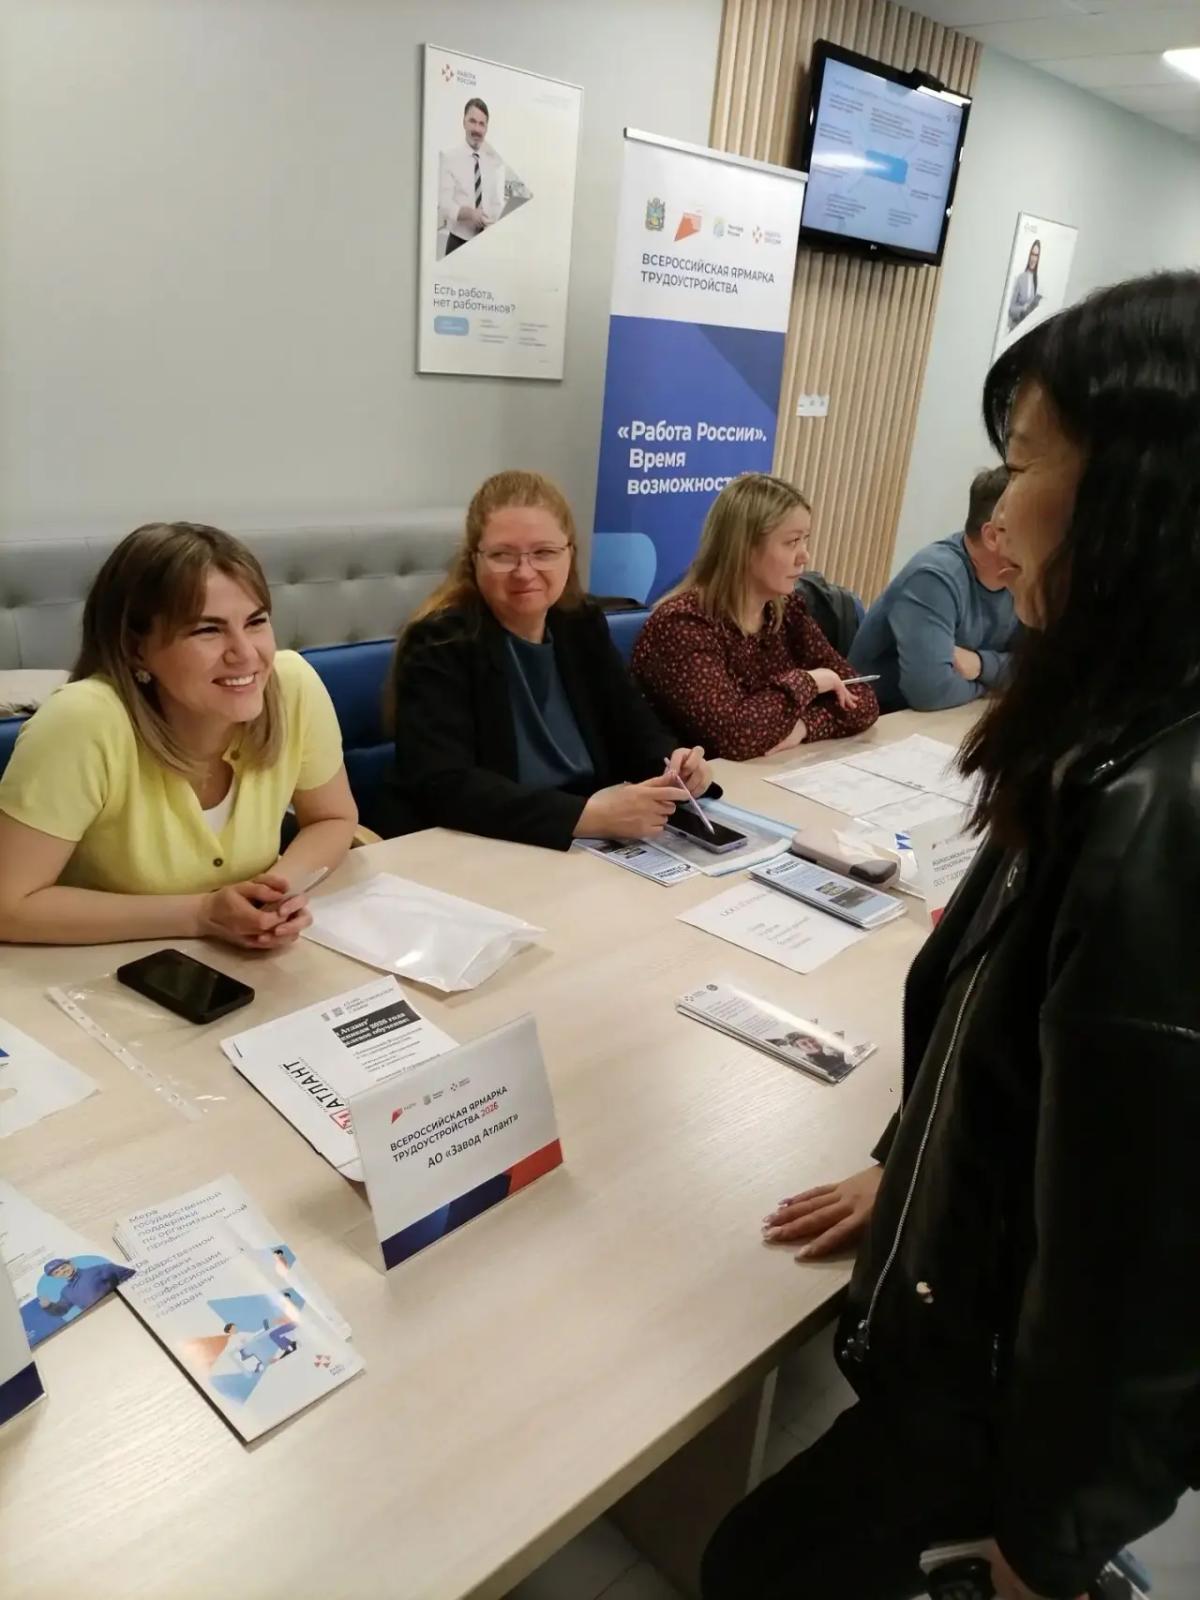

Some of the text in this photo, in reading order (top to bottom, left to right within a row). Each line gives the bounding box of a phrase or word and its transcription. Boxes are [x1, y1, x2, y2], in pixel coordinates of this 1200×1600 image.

[642, 252, 775, 283] ВСЕРОССИЙСКАЯ ЯРМАРКА
[434, 283, 495, 302] Есть работа,
[640, 270, 738, 294] ТРУДОУСТРОЙСТВА
[433, 298, 516, 314] нет работников?
[617, 419, 767, 442] «Работа России».
[629, 447, 686, 472] Время
[627, 474, 736, 495] возможност
[283, 1061, 344, 1108] АТЛАНТ
[390, 1106, 468, 1152] ВСЕРОССИЙСКАЯ
[468, 1085, 508, 1111] ЯРМАРКА
[393, 1101, 499, 1163] ТРУДОУСТРОЙСТВА 2026
[428, 1113, 519, 1168] АО «Завод Атлант»
